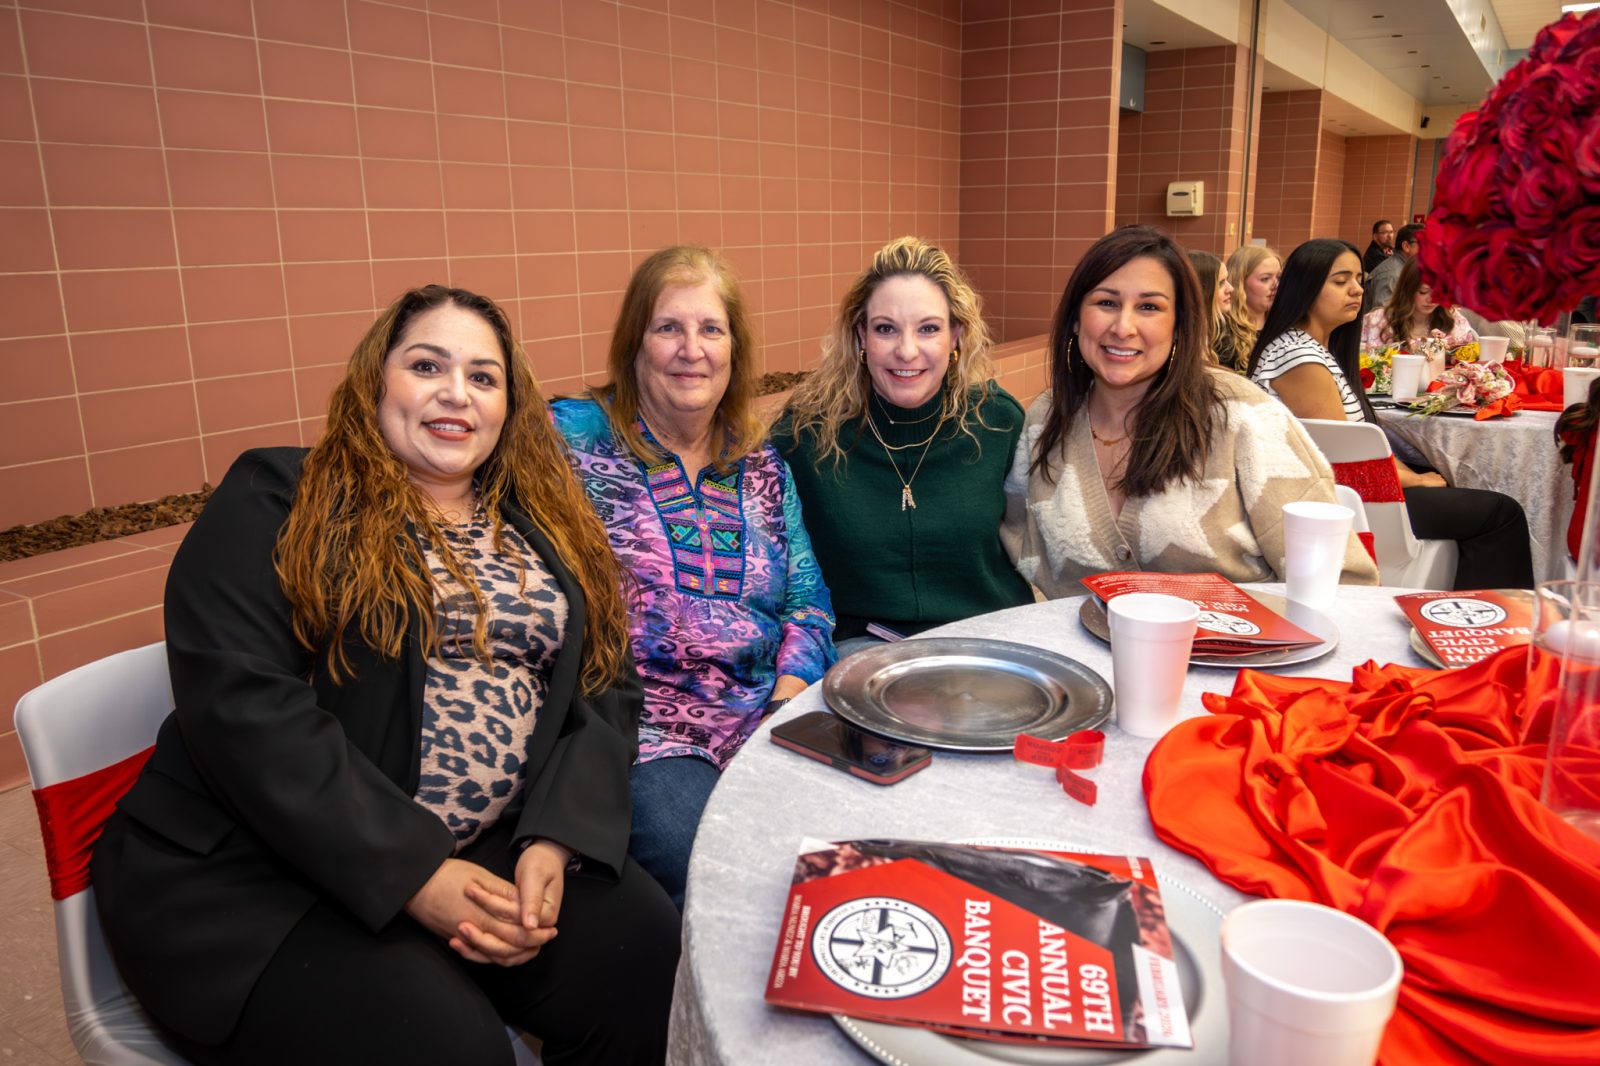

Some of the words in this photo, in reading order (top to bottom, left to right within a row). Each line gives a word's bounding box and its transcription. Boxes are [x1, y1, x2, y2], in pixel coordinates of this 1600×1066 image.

[1428, 627, 1532, 638] BANQUET
[1433, 637, 1495, 646] CIVIC
[1438, 646, 1506, 655] NUAL
[956, 898, 991, 1023] BANQUET
[1001, 949, 1032, 1026] CIVIC
[1038, 919, 1073, 1030] ANNUAL
[1079, 964, 1115, 1035] 69TH
